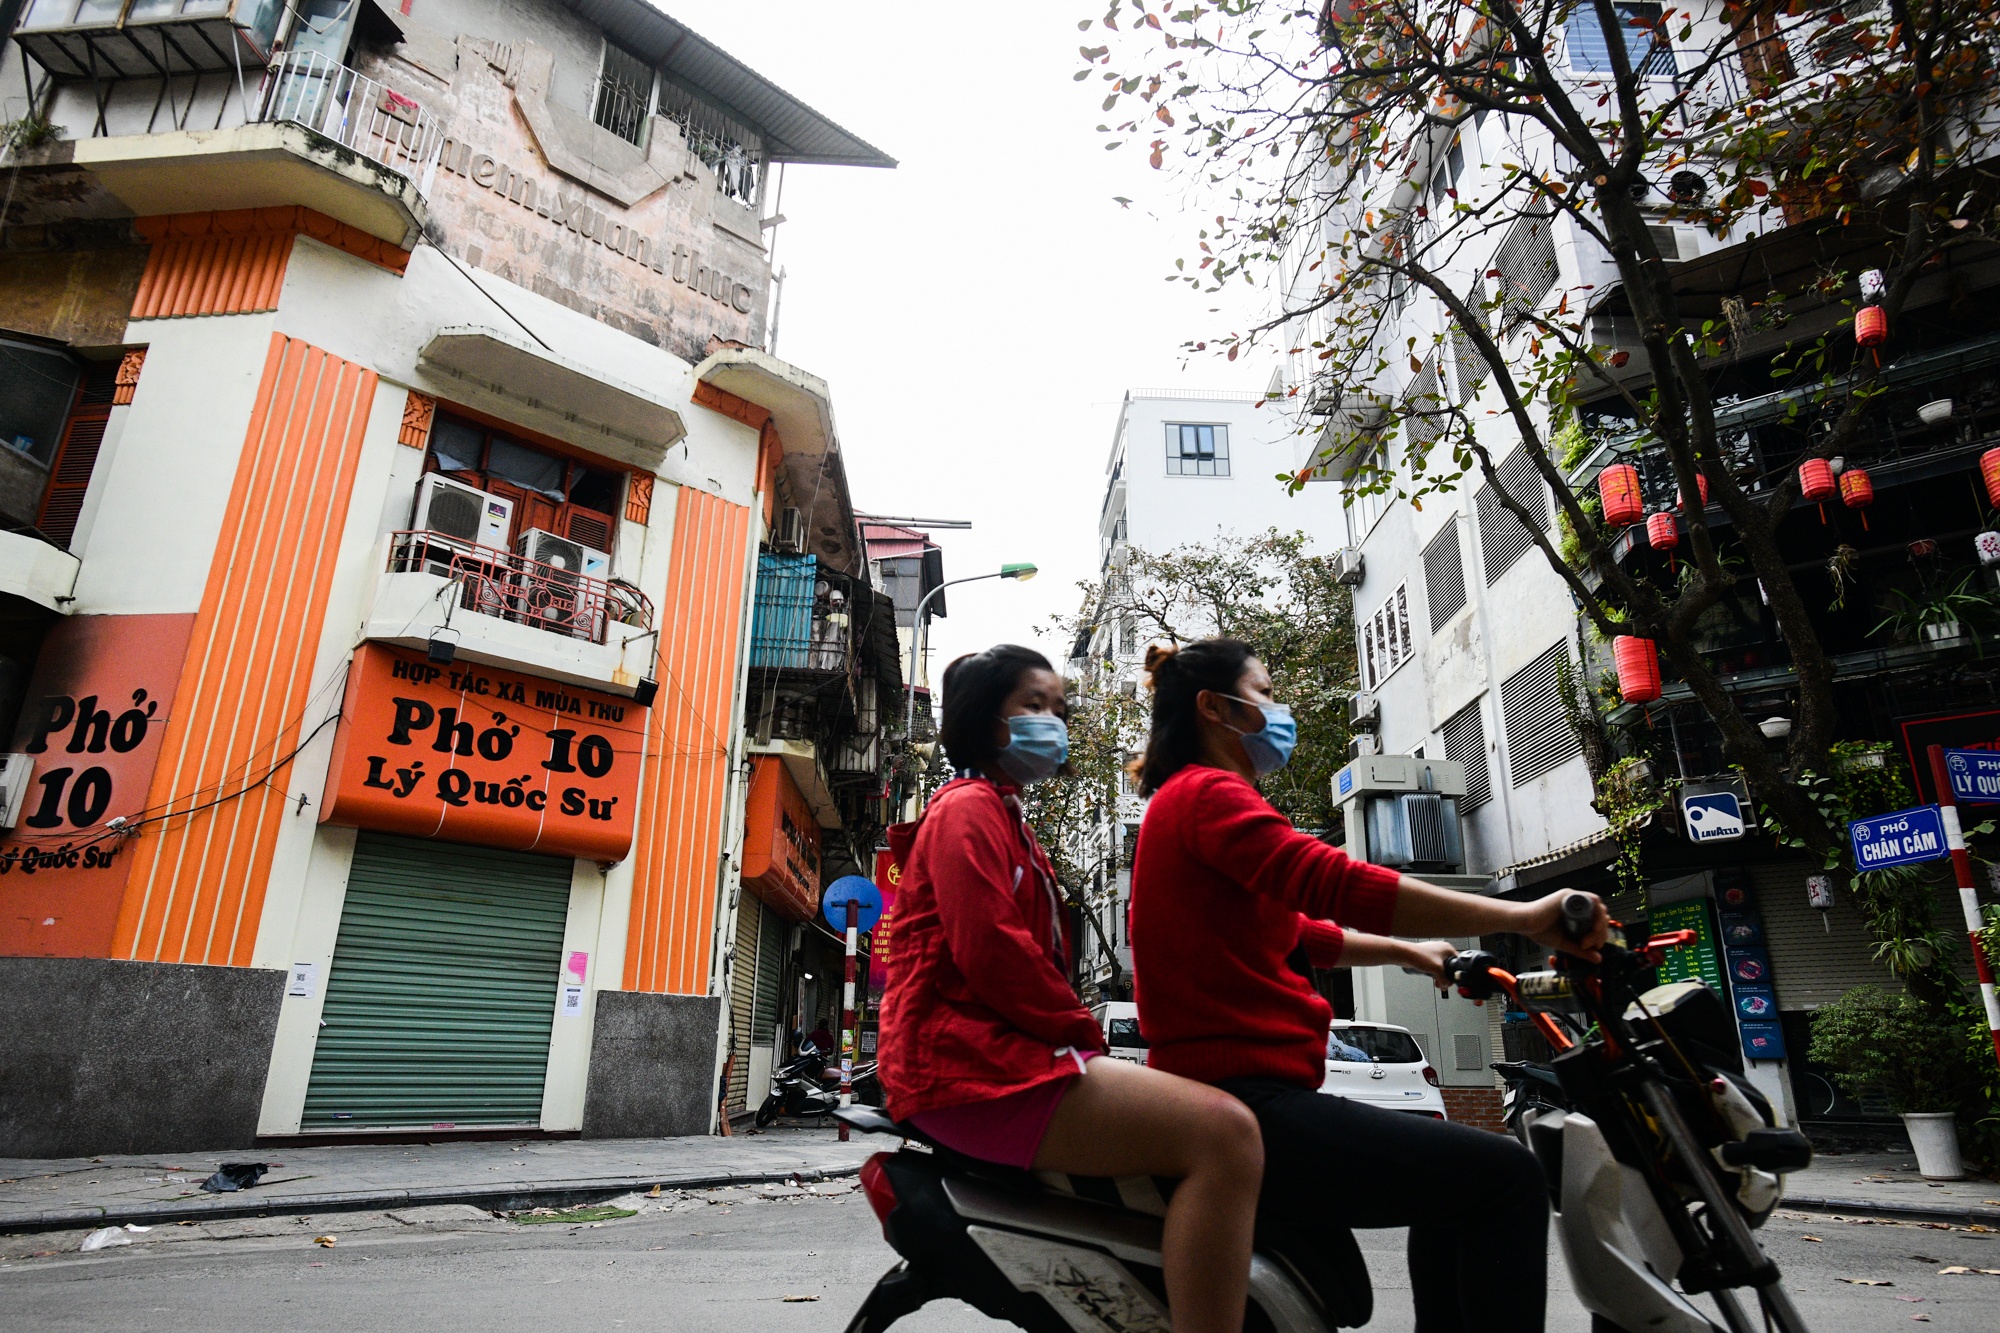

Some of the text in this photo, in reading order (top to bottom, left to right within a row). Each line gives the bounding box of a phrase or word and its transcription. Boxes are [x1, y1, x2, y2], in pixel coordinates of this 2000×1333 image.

[392, 660, 625, 722] HỢP TÁC XÃ MÙA THU
[25, 688, 157, 754] Phở
[387, 697, 614, 778] Phở 10
[25, 766, 112, 828] 10
[363, 755, 618, 821] Lý Quốc Sư
[1955, 771, 1973, 793] LÝ
[1701, 826, 1740, 838] LAVAZZA
[1880, 816, 1909, 835] PHỐ
[0, 842, 119, 875] ý Quốc Sư
[1862, 837, 1901, 862] CHÂN
